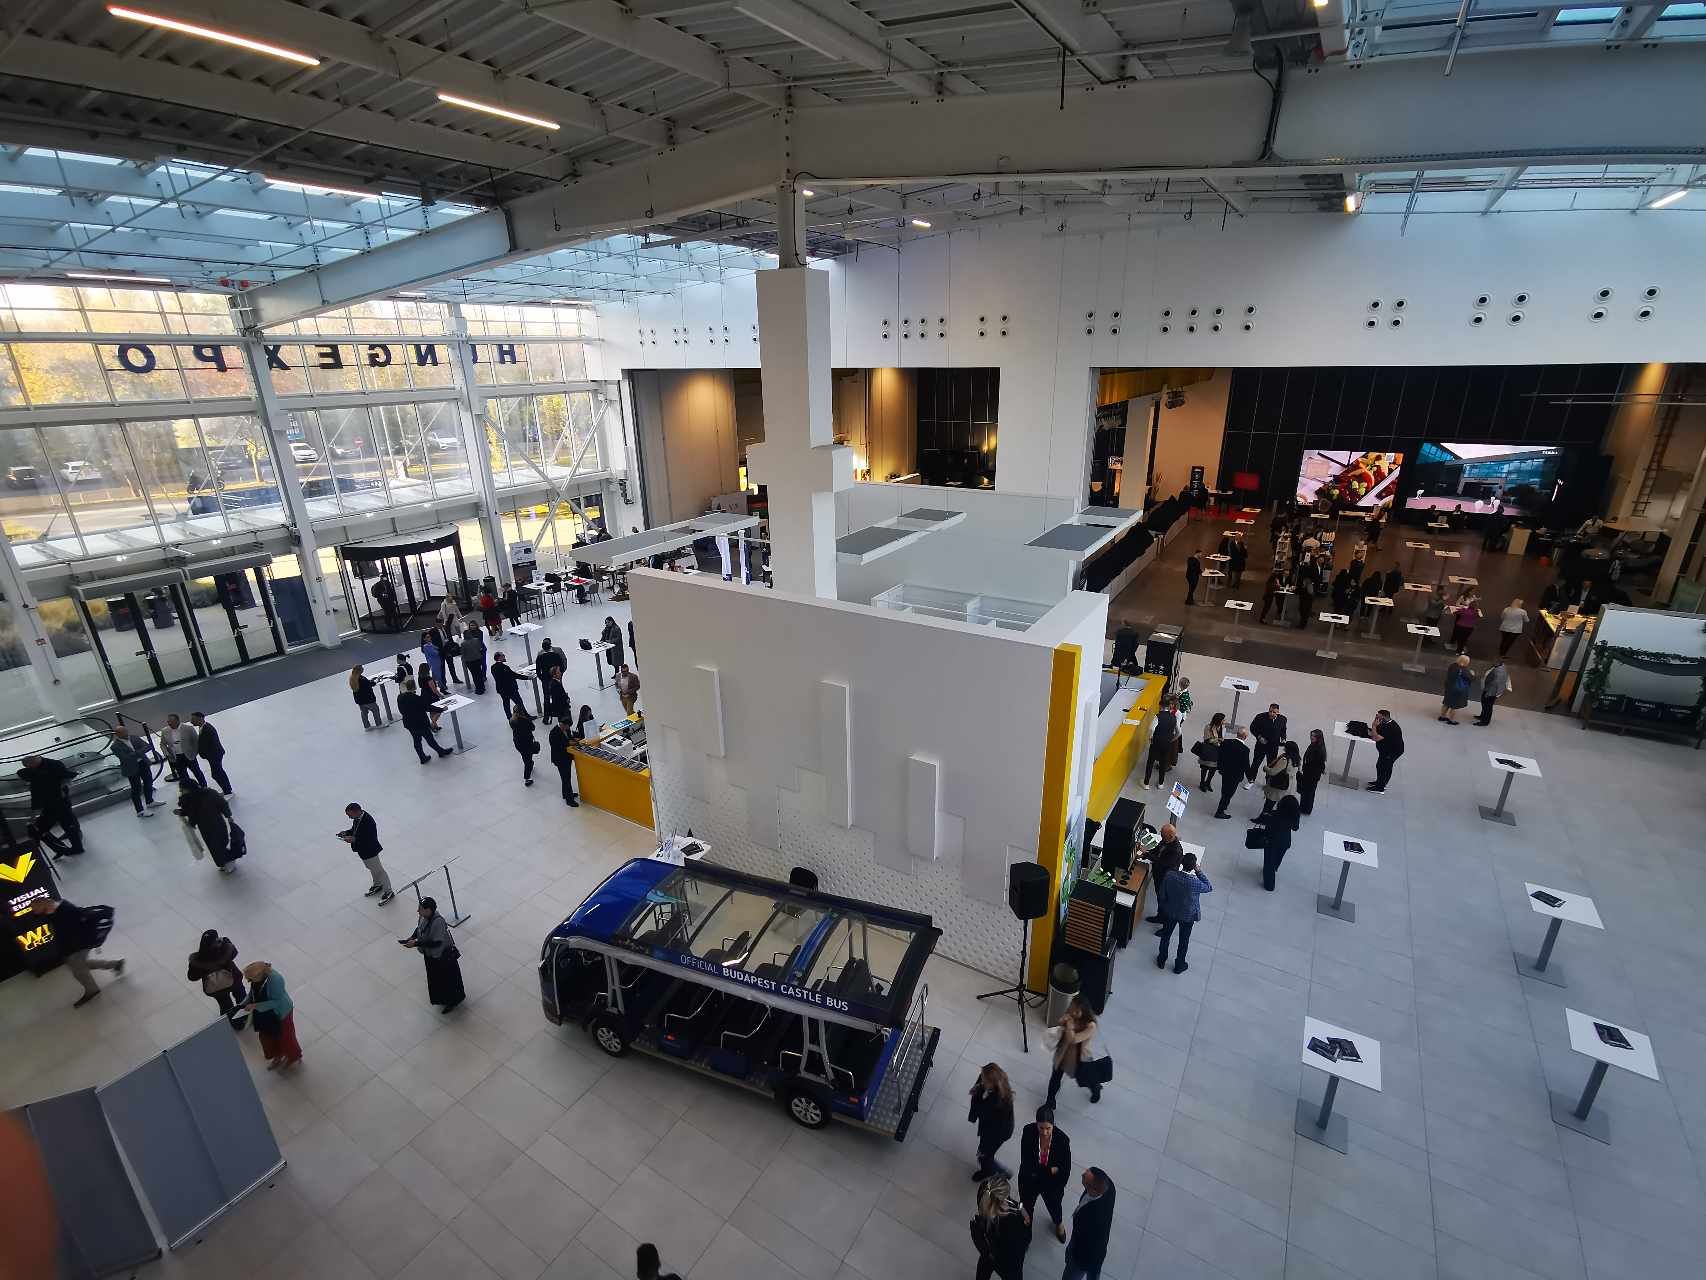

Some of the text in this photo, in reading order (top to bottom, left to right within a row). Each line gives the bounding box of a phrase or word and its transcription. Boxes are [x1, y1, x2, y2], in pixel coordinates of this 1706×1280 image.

[9, 886, 47, 905] VISUAL
[680, 954, 849, 1011] OFFICIAL BUDAPEST CASTLE BUS
